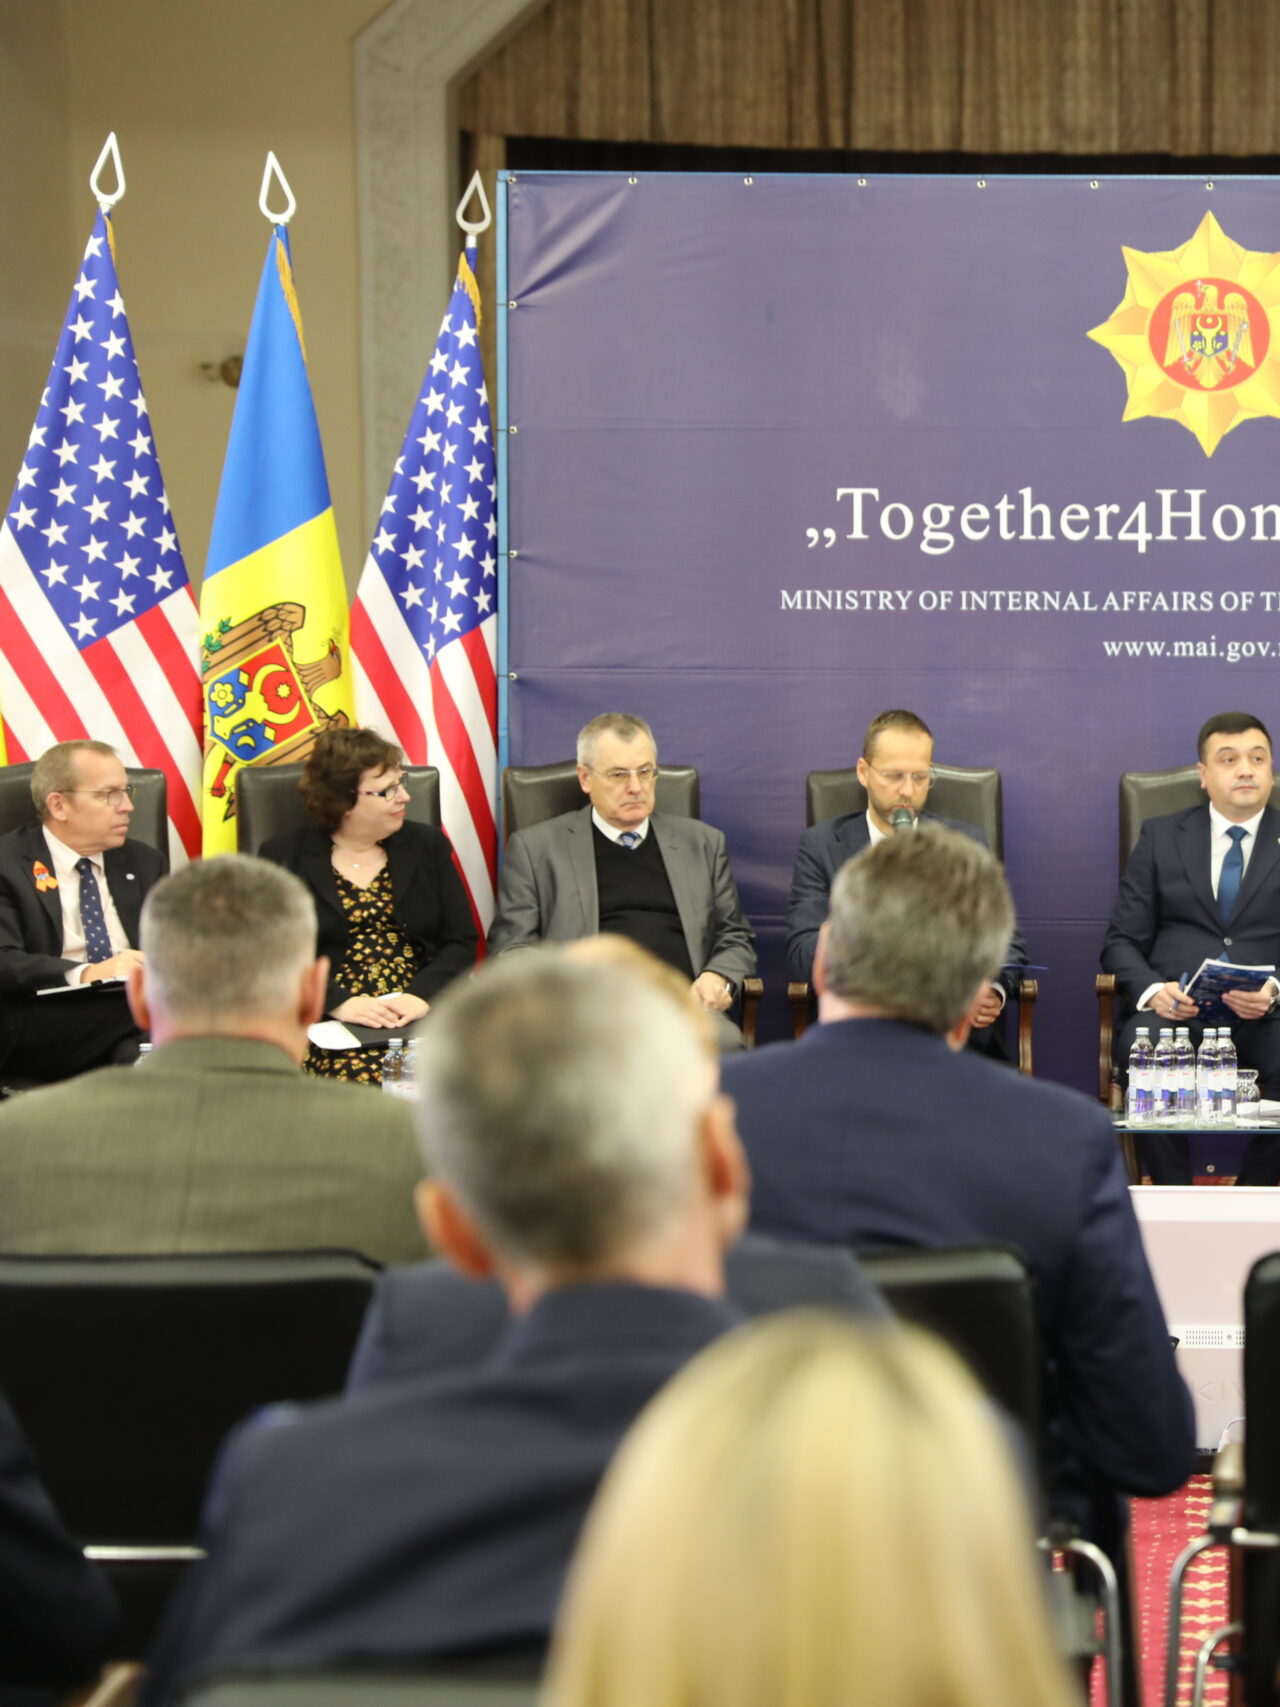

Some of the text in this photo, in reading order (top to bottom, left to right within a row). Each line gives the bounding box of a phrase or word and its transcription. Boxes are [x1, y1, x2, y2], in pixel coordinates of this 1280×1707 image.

[779, 589, 914, 611] MINISTRY
[918, 589, 954, 611] OF
[959, 590, 1099, 612] INTERNAL
[1101, 590, 1215, 612] AFFAIRS
[1219, 590, 1255, 613] OF
